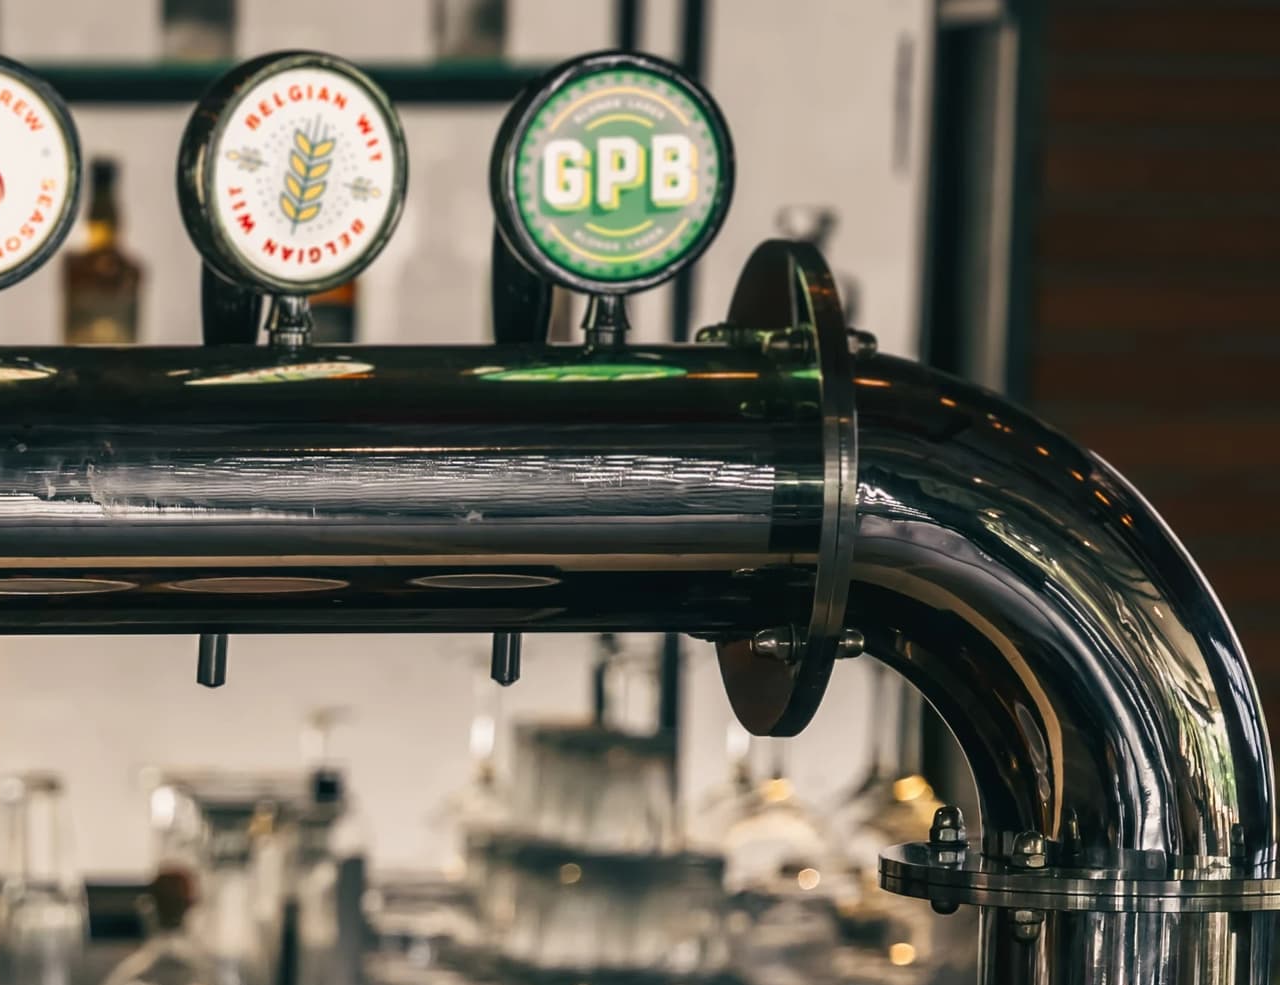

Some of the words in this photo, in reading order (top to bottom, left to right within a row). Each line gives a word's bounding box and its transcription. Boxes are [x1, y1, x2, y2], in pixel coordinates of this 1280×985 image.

[244, 84, 348, 130] BELGIAN
[356, 113, 383, 162] WIT
[542, 132, 698, 212] GPB
[228, 186, 256, 234] WIT
[262, 218, 365, 265] BELGIAN
